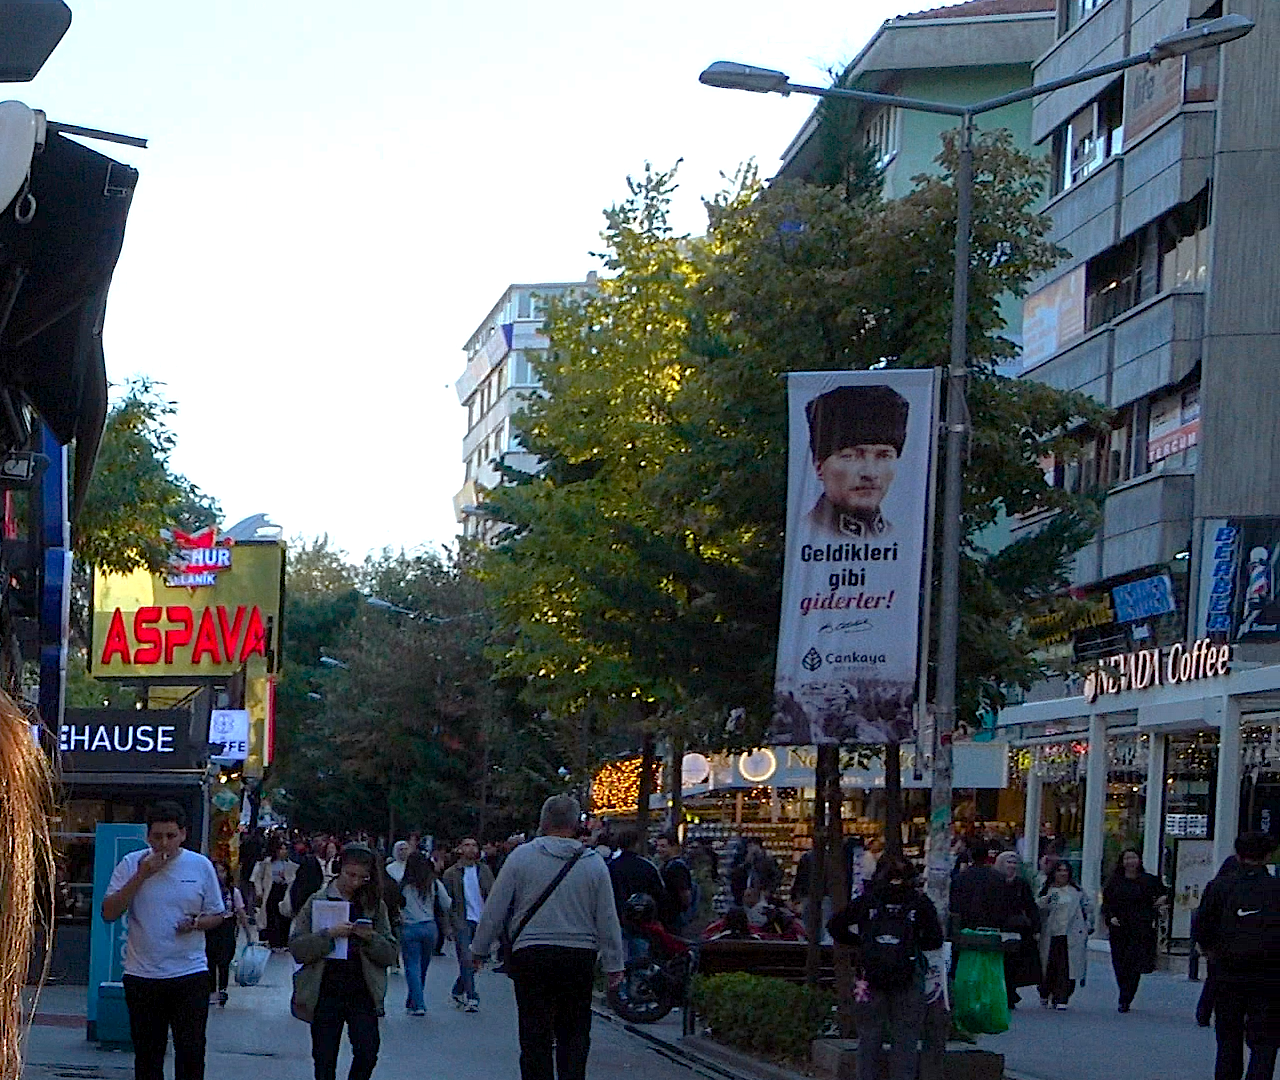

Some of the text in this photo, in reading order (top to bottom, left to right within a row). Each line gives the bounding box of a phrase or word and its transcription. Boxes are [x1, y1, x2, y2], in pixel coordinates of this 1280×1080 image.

[801, 542, 898, 563] Geldikleri
[829, 568, 866, 591] gibi
[800, 590, 895, 616] giderler!
[101, 605, 266, 664] ASPAVA
[1167, 638, 1230, 684] Coffee
